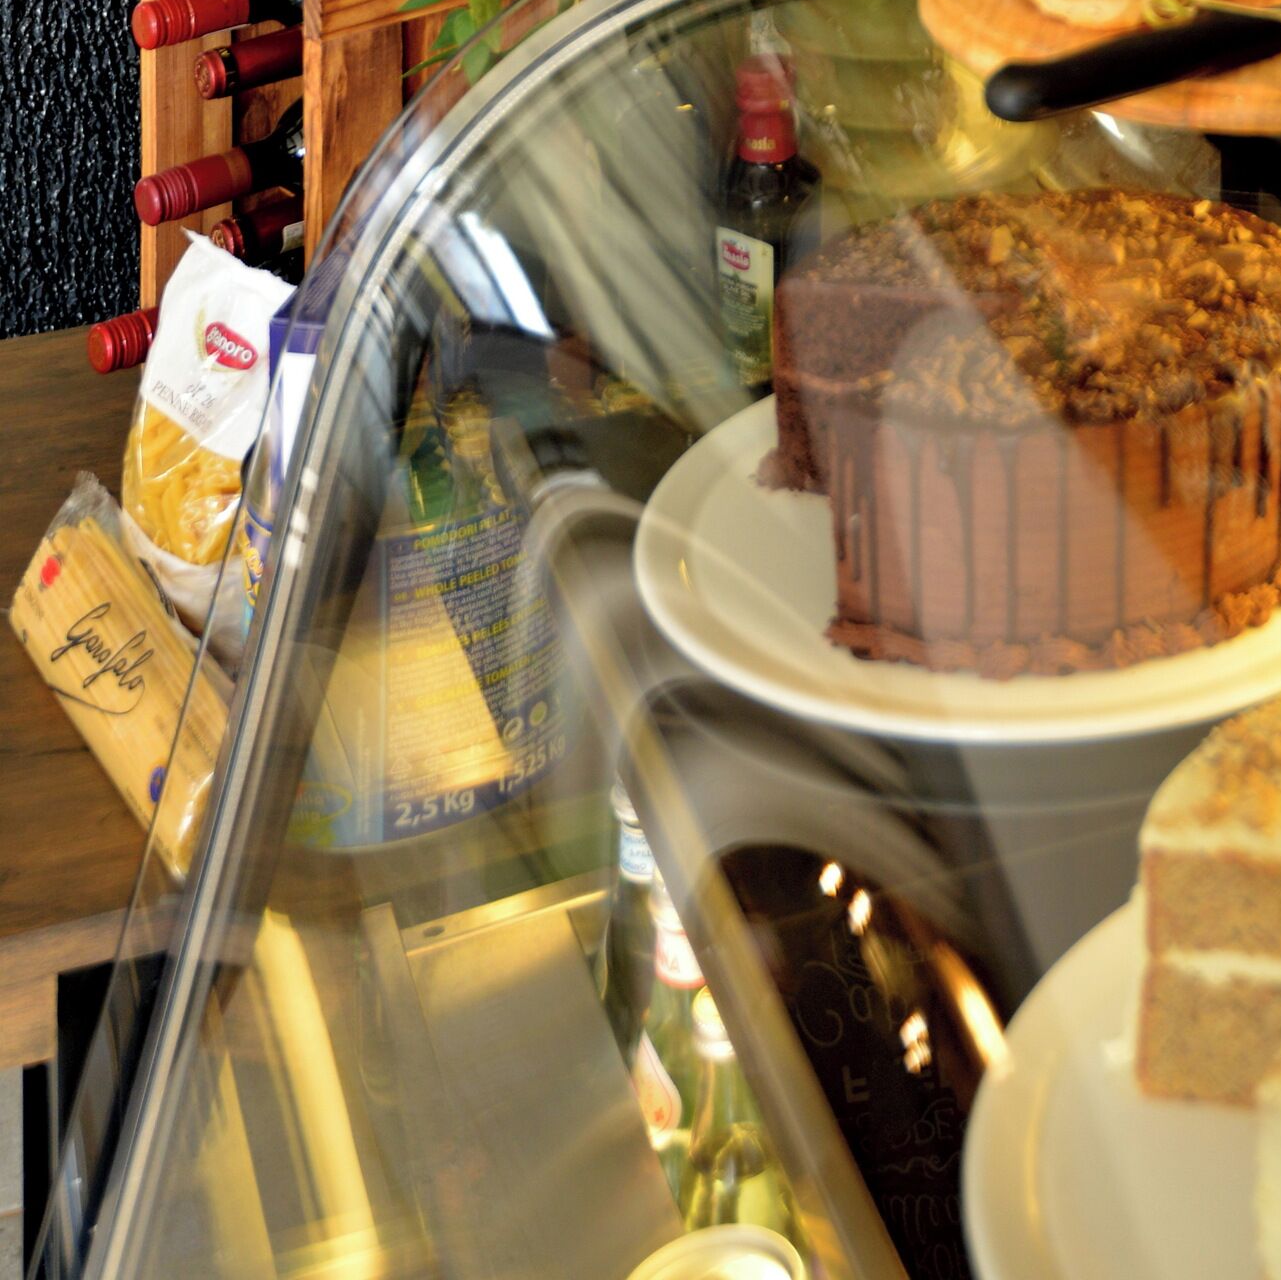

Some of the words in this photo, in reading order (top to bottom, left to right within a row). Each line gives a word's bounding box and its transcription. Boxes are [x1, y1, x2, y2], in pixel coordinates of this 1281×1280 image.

[458, 562, 500, 588] PEELED
[394, 795, 439, 828] 2,5
[443, 789, 476, 815] Kg
